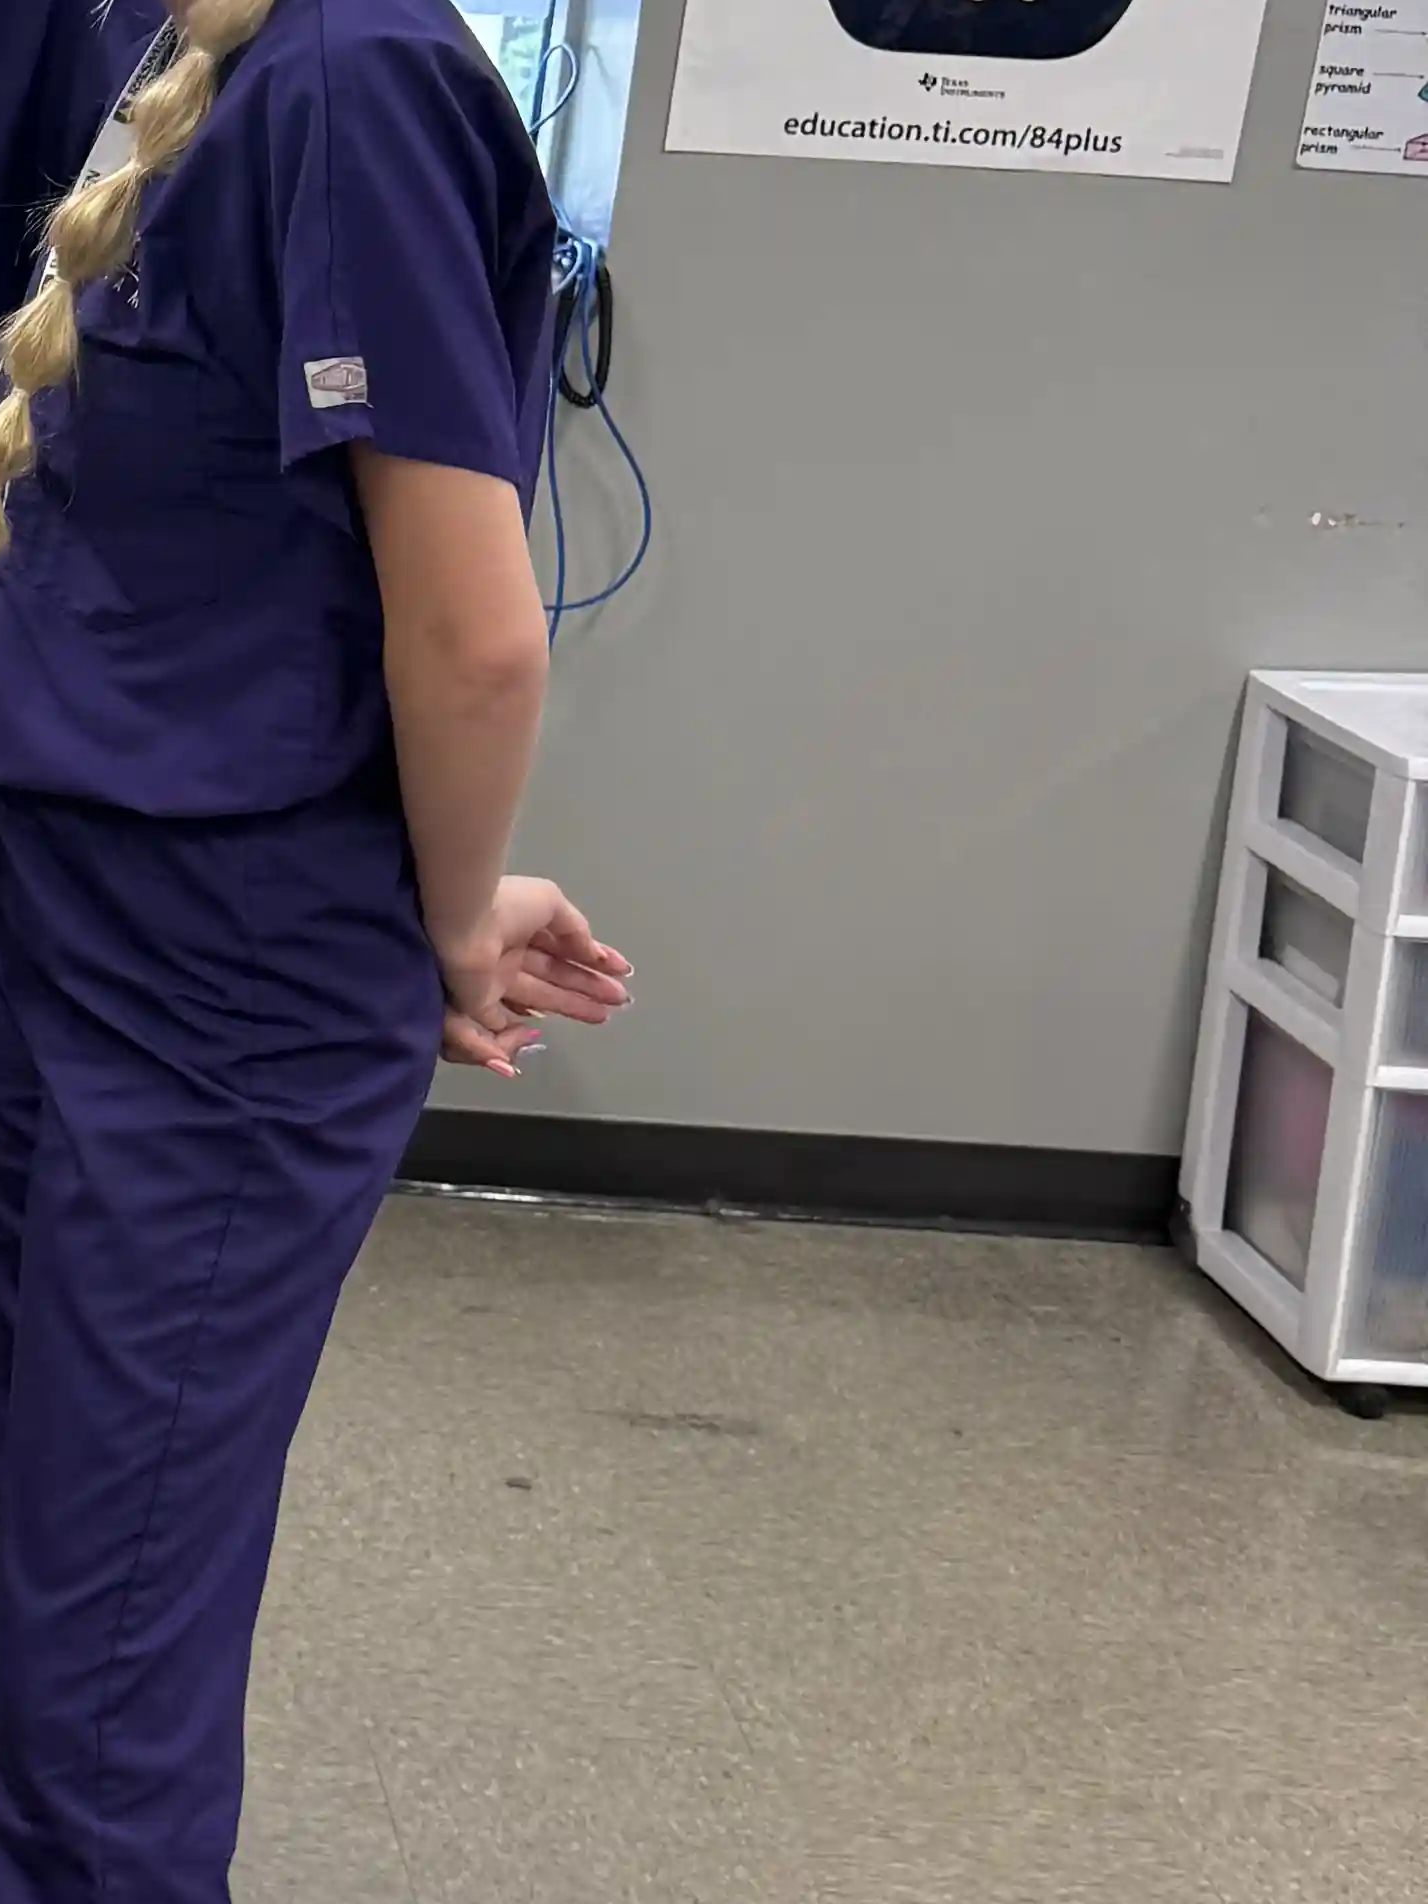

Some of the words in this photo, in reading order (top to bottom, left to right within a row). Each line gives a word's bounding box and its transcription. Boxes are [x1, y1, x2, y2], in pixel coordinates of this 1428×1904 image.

[1328, 4, 1398, 22] triangular
[1323, 22, 1363, 36] prism
[1319, 64, 1365, 78] square
[1314, 81, 1372, 96] pyramid
[784, 112, 1123, 156] education.ti.com/84plus
[1303, 125, 1385, 142] rectangular
[1300, 142, 1338, 156] prism
